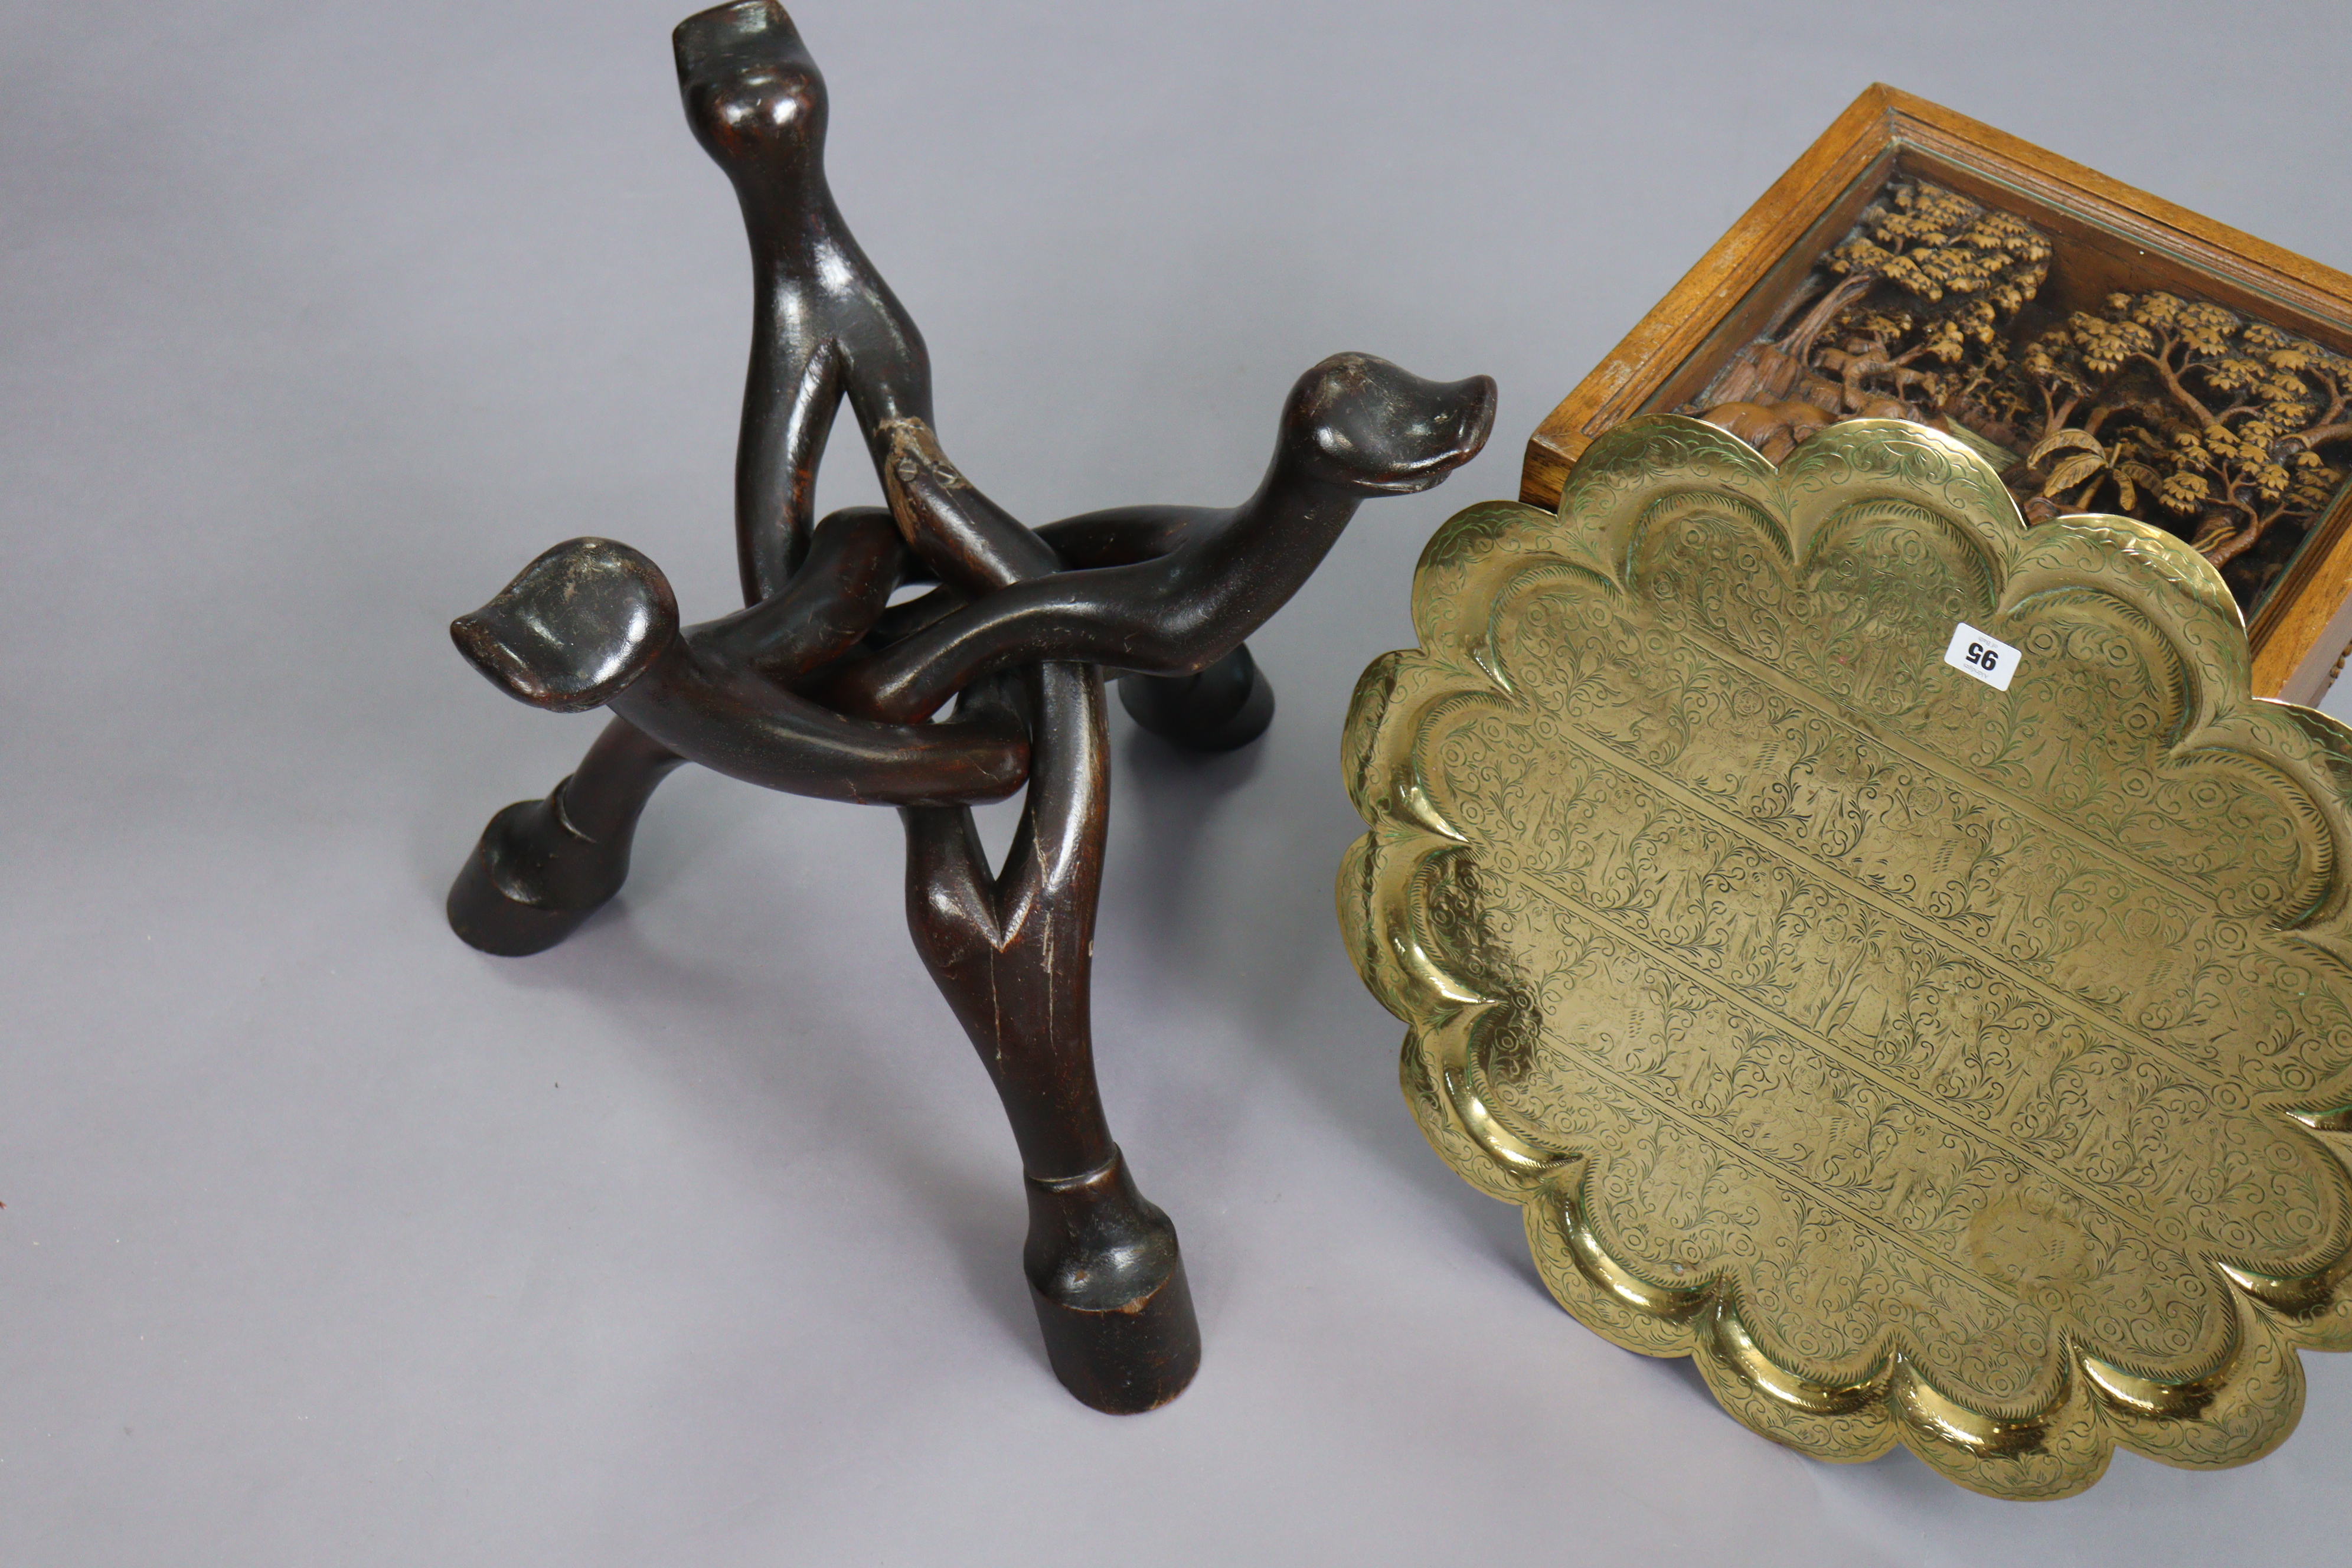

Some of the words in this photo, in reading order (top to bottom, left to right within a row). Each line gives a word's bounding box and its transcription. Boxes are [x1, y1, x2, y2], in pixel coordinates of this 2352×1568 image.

[1978, 636, 1991, 646] Bath
[1965, 642, 1998, 671] 95
[1964, 664, 1989, 679] Aldridges
